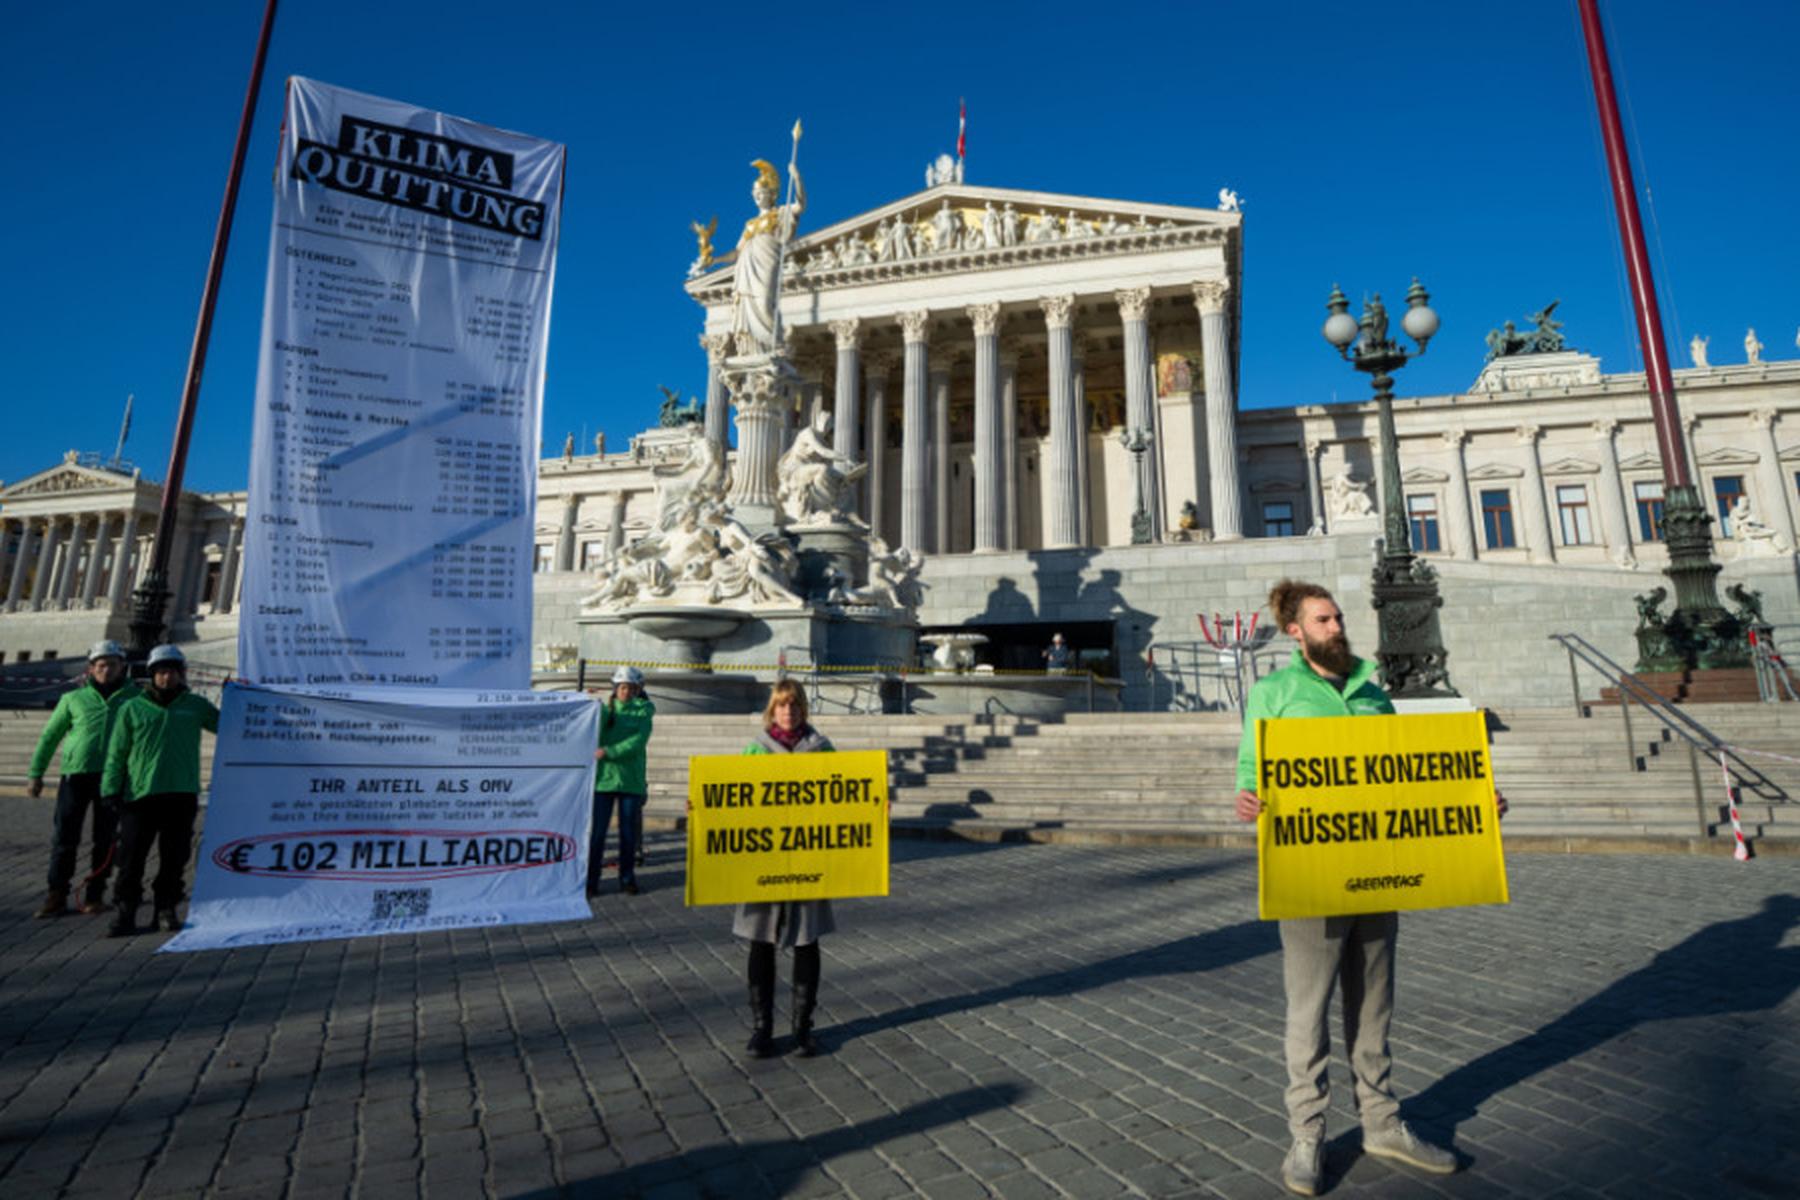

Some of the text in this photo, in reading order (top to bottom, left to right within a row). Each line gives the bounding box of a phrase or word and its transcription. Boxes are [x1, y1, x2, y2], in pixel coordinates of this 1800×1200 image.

[352, 125, 502, 186] KLIMA
[298, 147, 541, 235] QUITTUNG
[275, 341, 319, 357] Europa
[305, 408, 348, 421] Kanada
[368, 413, 410, 427] Mexiko
[261, 514, 298, 526] China
[258, 604, 302, 615] Indien
[246, 703, 270, 713] Ihr
[1262, 751, 1485, 789] FOSSILE KONZERNE
[309, 779, 513, 793] IHR ANTEIL ALS OMV
[703, 774, 880, 808] WER ZERSTÖRT,
[1274, 806, 1483, 846] MÜSSEN ZAHLEN!
[706, 823, 872, 854] MUSS ZAHLEN!
[230, 837, 565, 872] € 102 MILLIARDEN
[757, 873, 823, 886] GREENPEACE
[1345, 873, 1424, 892] GREENPEACE
